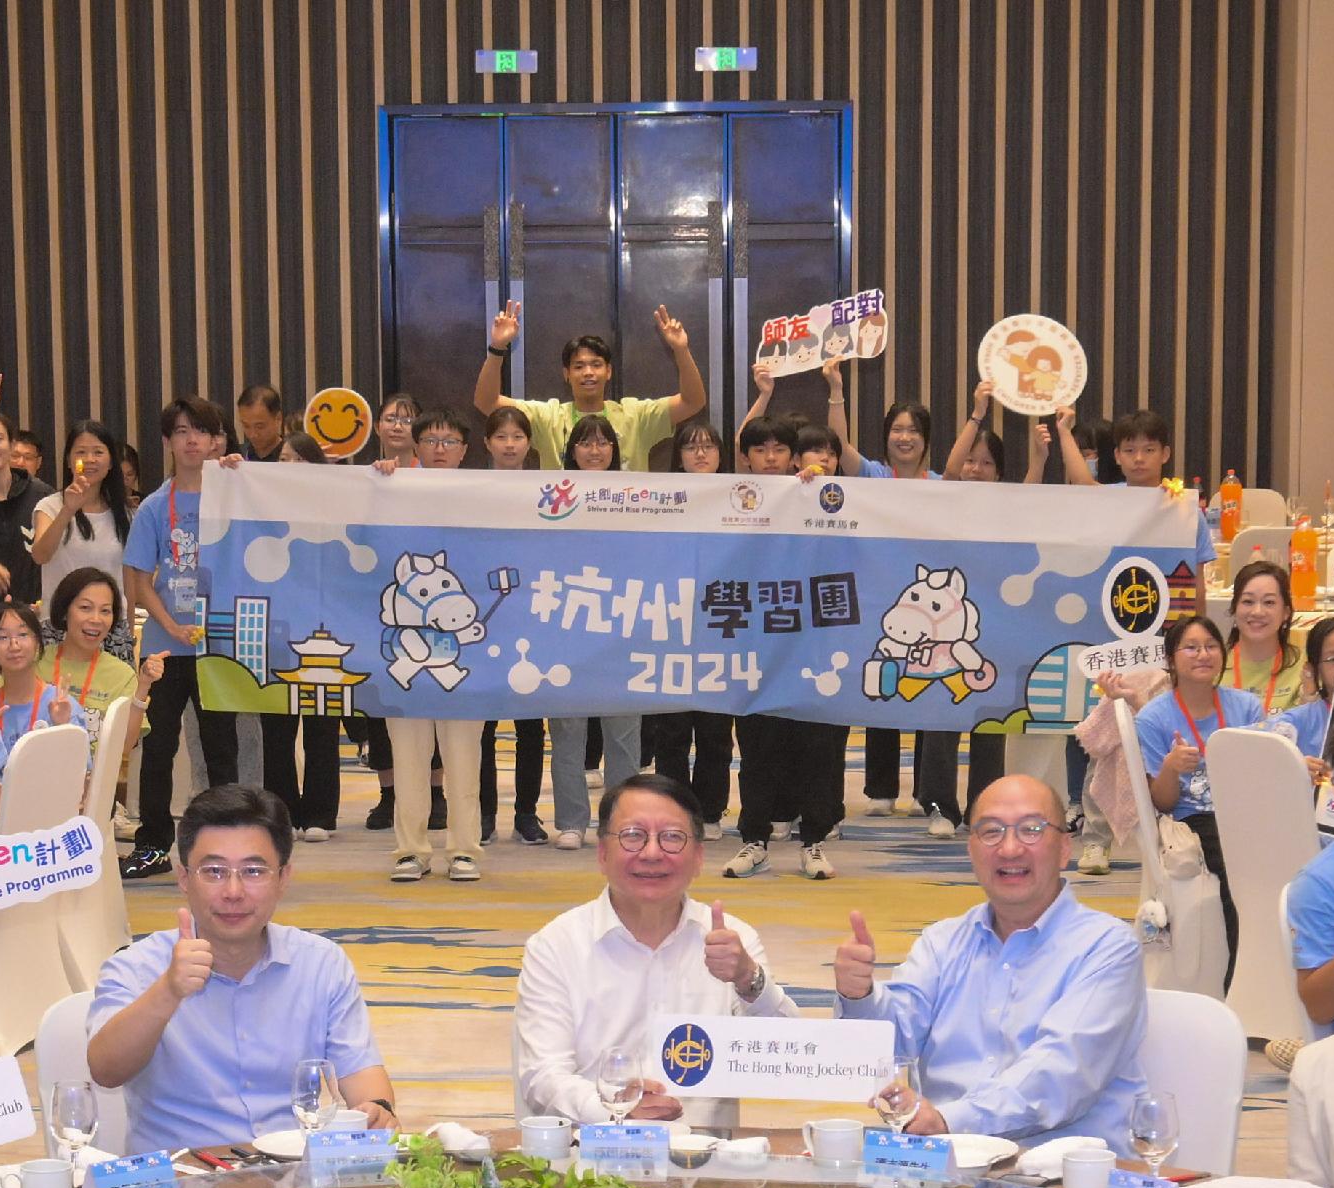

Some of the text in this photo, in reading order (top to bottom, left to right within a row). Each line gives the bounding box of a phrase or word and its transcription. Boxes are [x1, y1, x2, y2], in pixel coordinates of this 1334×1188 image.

[763, 290, 882, 346] 師友 配對
[625, 506, 640, 514] Rise
[642, 507, 685, 515] Programme
[530, 565, 860, 646] 杭州學習團
[627, 651, 762, 695] 2024
[5, 863, 94, 895] Programme
[730, 1039, 819, 1056] 香港賽馬會
[727, 1060, 749, 1073] The
[752, 1061, 781, 1076] Hong
[785, 1062, 813, 1078] Kong
[814, 1063, 855, 1080] Jockey
